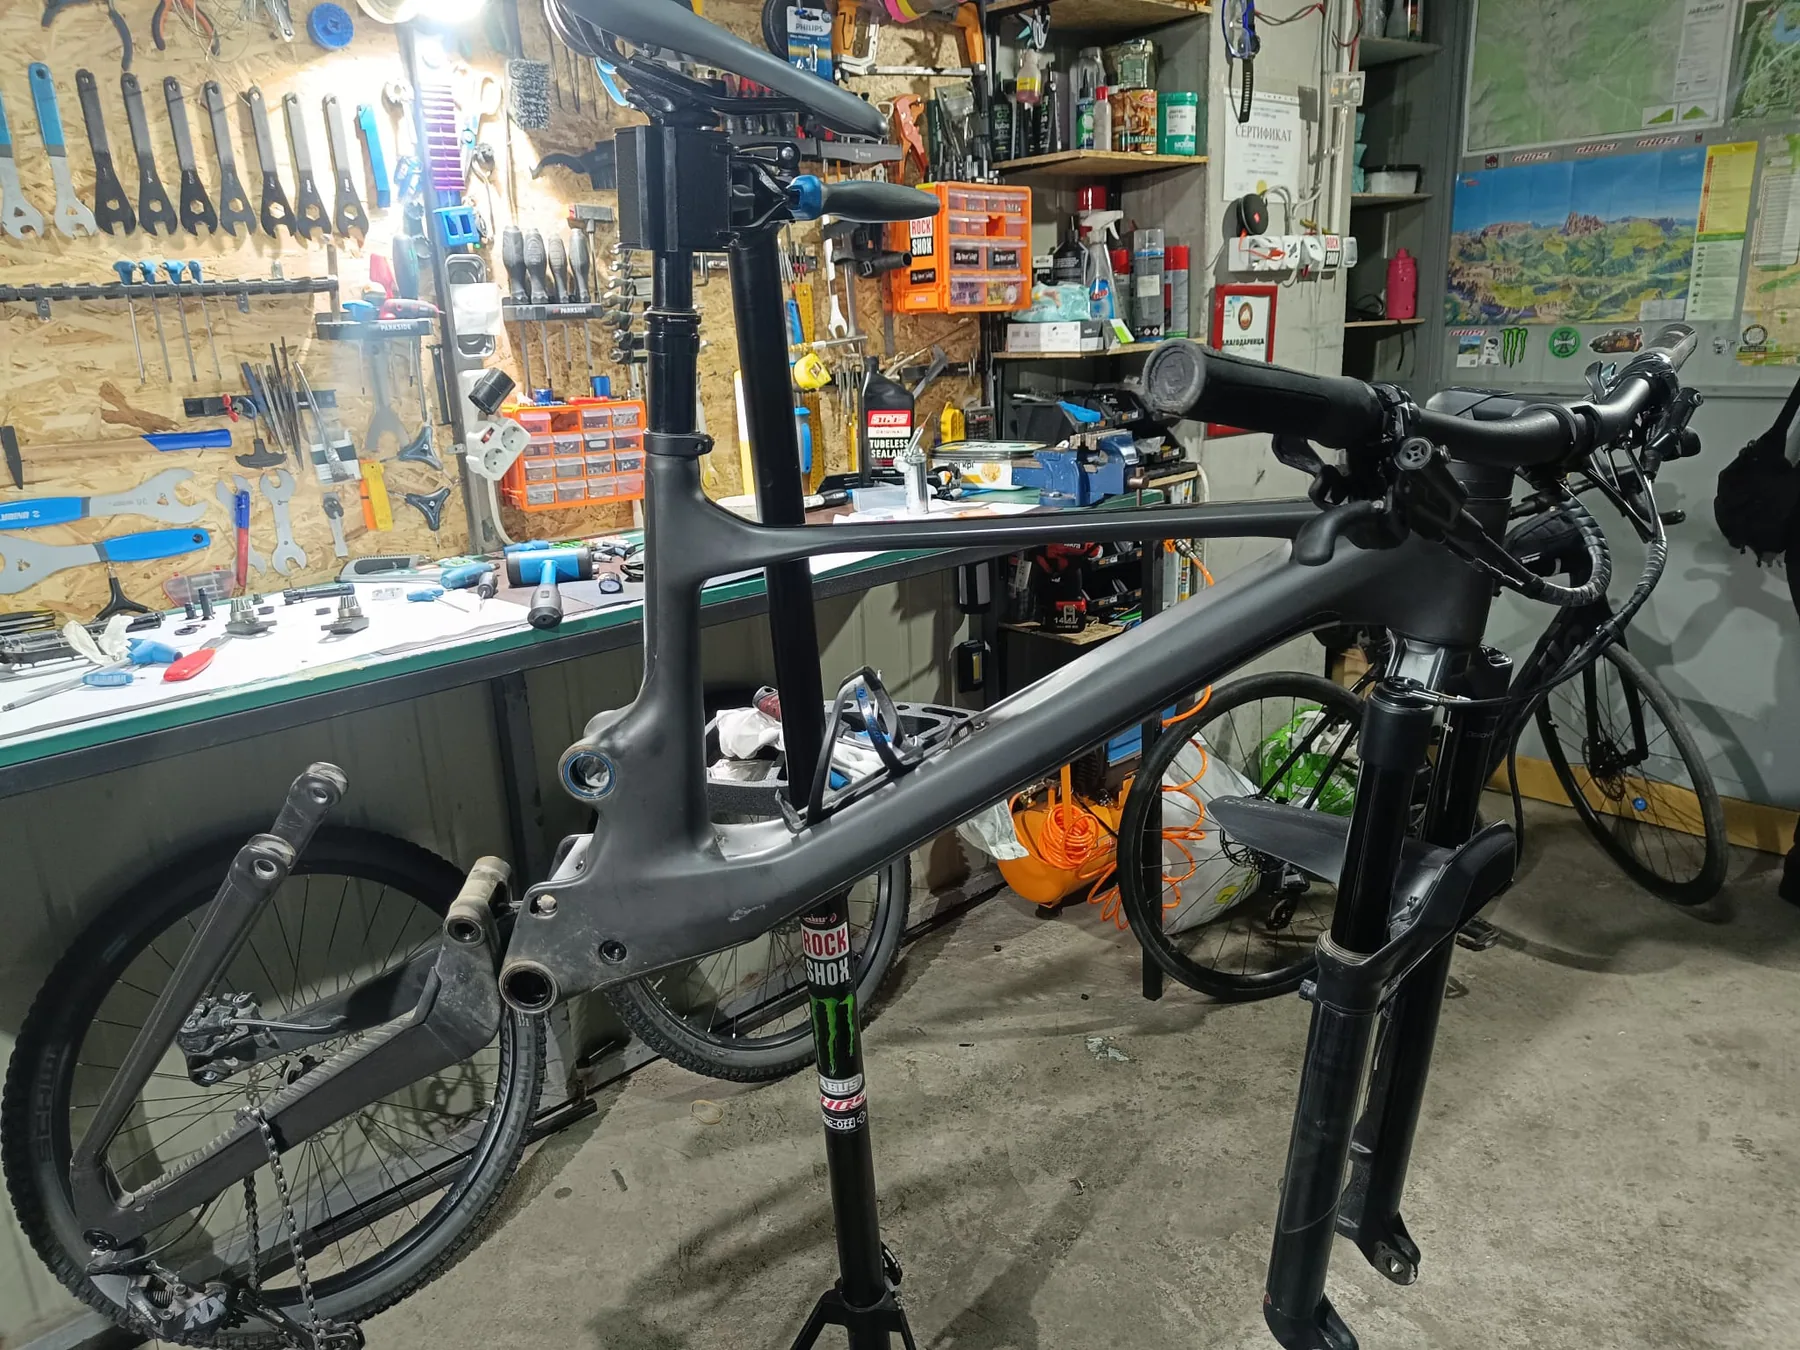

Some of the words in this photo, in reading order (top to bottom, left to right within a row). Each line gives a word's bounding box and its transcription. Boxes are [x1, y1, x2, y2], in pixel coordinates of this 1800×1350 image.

[796, 23, 824, 32] PHILIPS
[1235, 124, 1292, 141] СЕРТИФИКАТ
[911, 219, 931, 235] ROCK
[912, 237, 933, 255] SHOX
[381, 324, 411, 332] PARKSIDE
[870, 440, 909, 449] TUBELESS
[871, 449, 904, 459] SEALAN
[802, 927, 847, 957] ROCK
[806, 957, 850, 986] SHOX
[820, 1079, 858, 1092] ABUS
